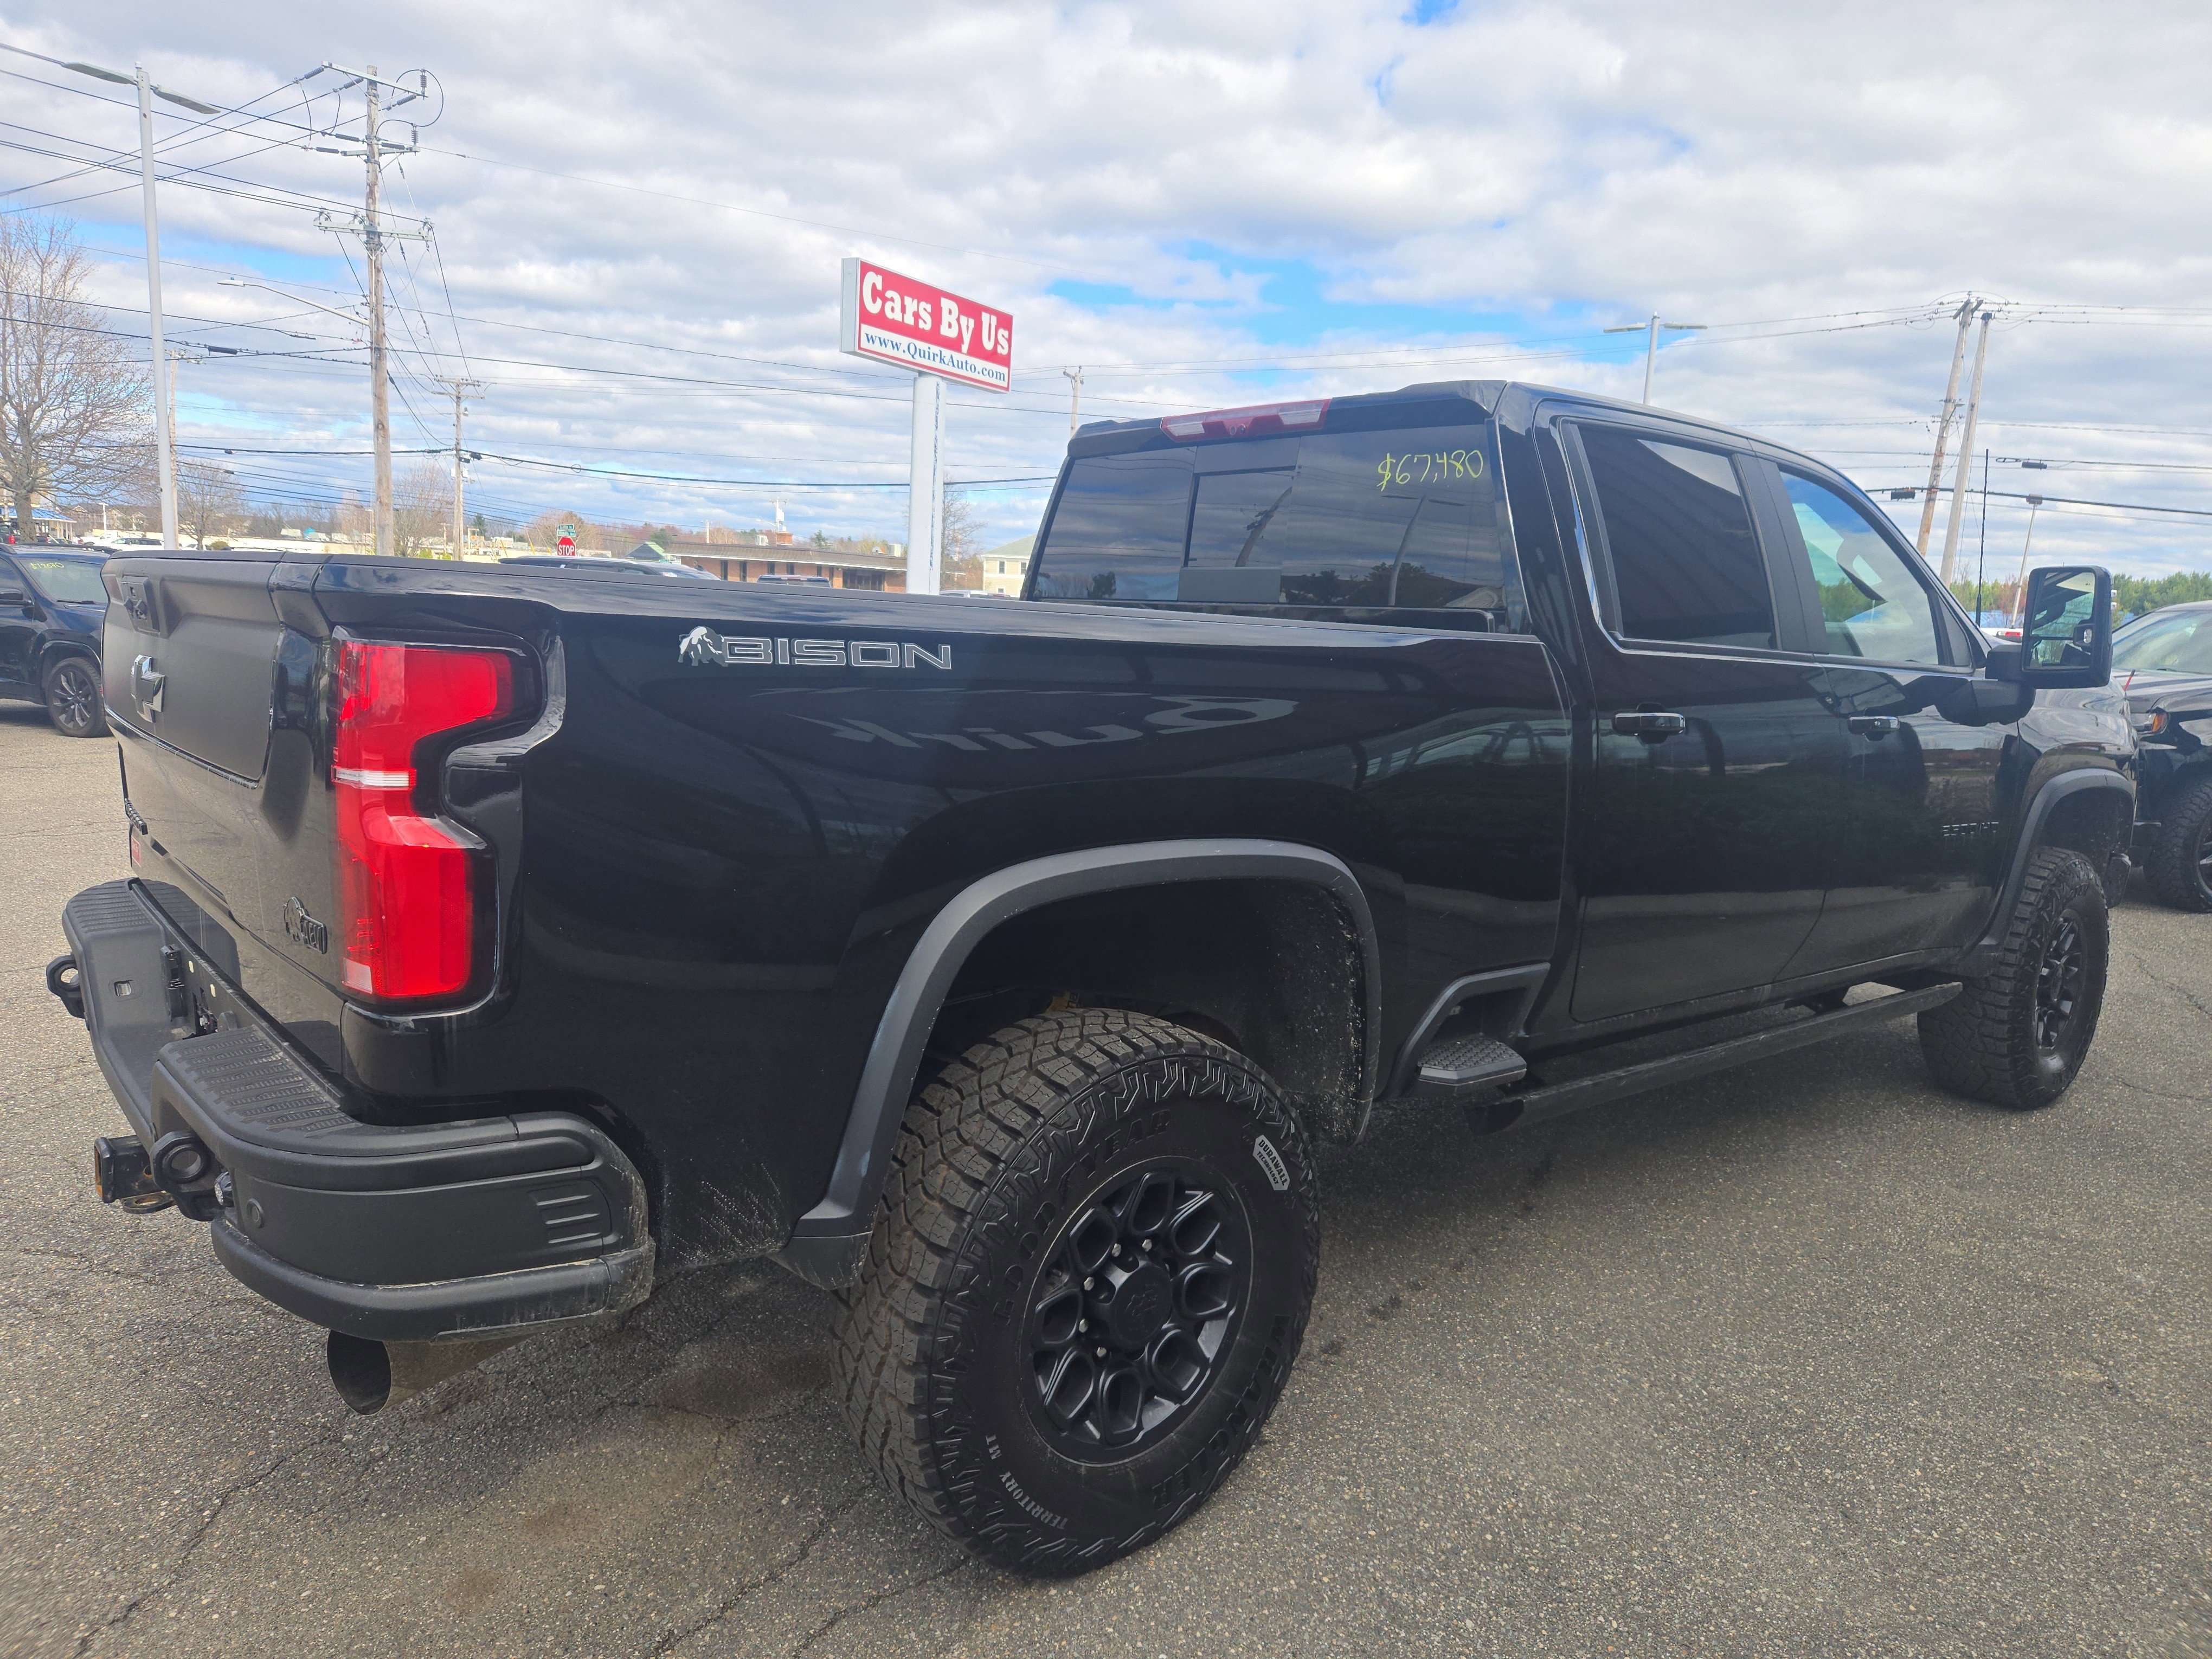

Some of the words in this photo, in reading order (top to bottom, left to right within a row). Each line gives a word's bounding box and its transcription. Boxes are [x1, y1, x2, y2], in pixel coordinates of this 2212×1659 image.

[863, 271, 932, 331] Cars
[941, 298, 974, 354] By
[982, 312, 1009, 356] Us
[865, 332, 1006, 382] www.QuirkAuto.com
[1377, 450, 1483, 491] $67,480
[558, 545, 575, 556] STOP
[724, 636, 951, 670] BISON
[1257, 1151, 1279, 1184] TECHNOLOGY
[1258, 1139, 1288, 1186] DURAWALL
[985, 1434, 1002, 1459] MT
[1000, 1471, 1068, 1529] TERRITORY
